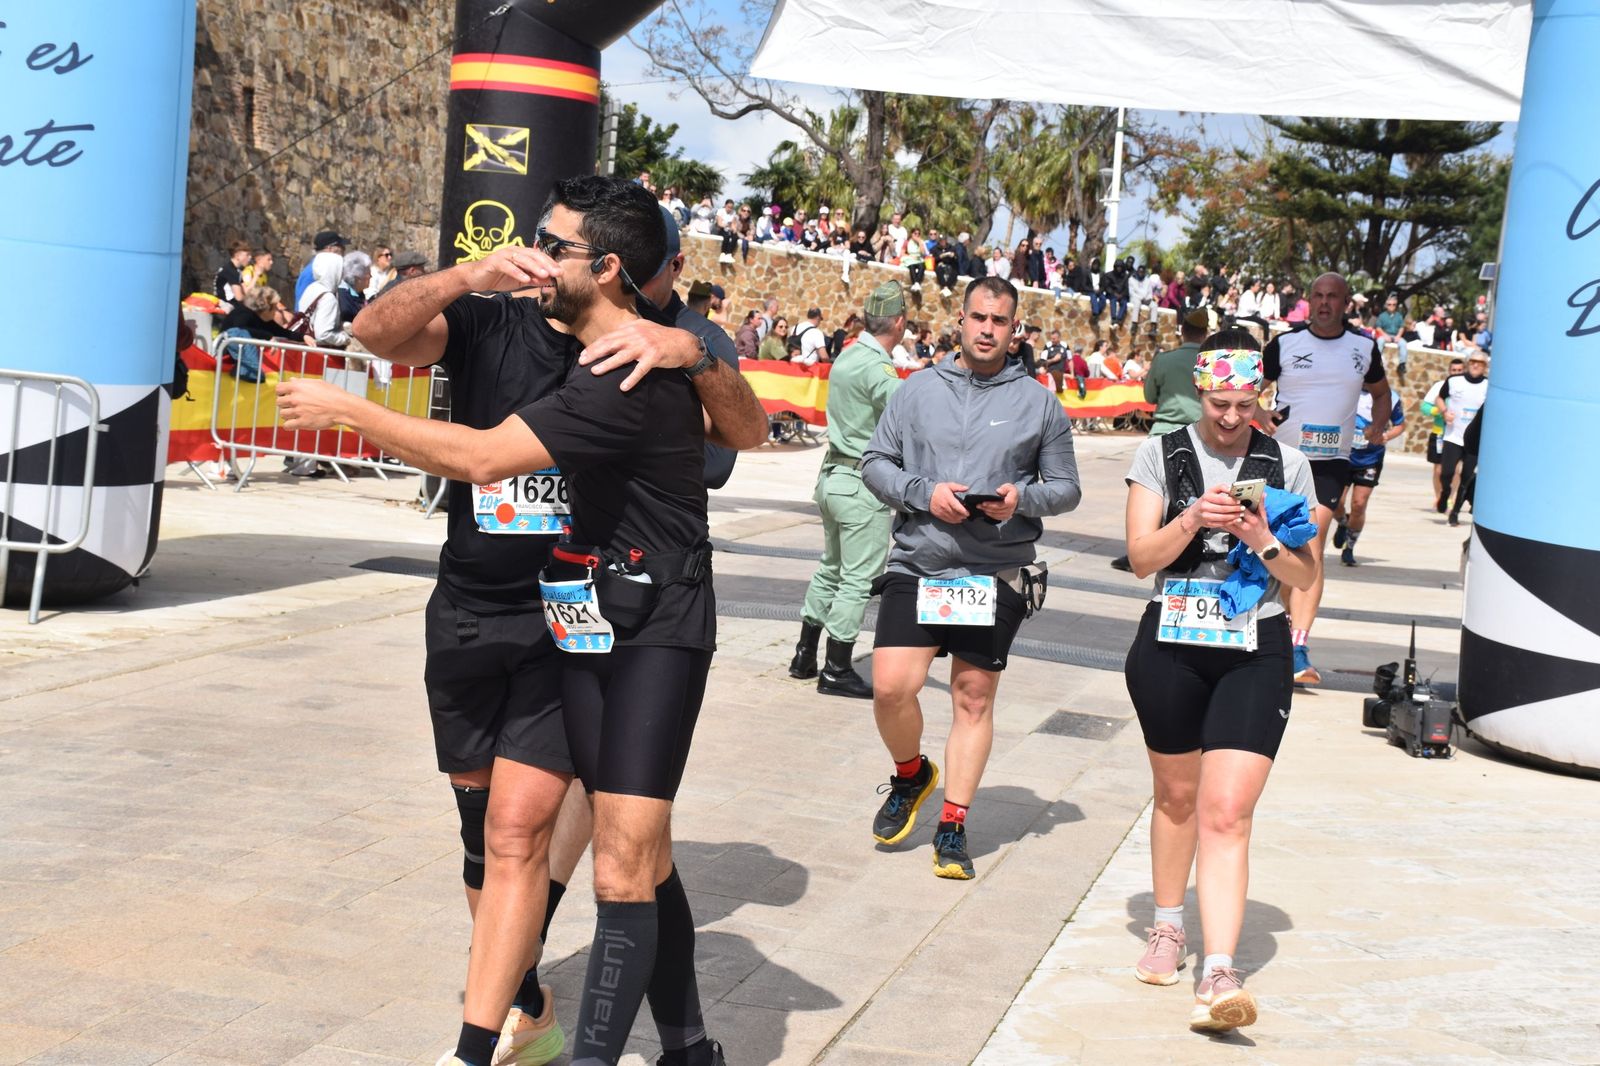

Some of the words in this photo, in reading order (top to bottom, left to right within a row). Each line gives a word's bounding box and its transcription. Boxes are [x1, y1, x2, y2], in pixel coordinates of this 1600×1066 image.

[26, 42, 94, 75] es
[1316, 432, 1340, 444] 1980
[946, 588, 987, 606] 3132
[547, 602, 598, 624] 1621
[1196, 598, 1233, 622] 94
[583, 928, 636, 1047] kalenji
